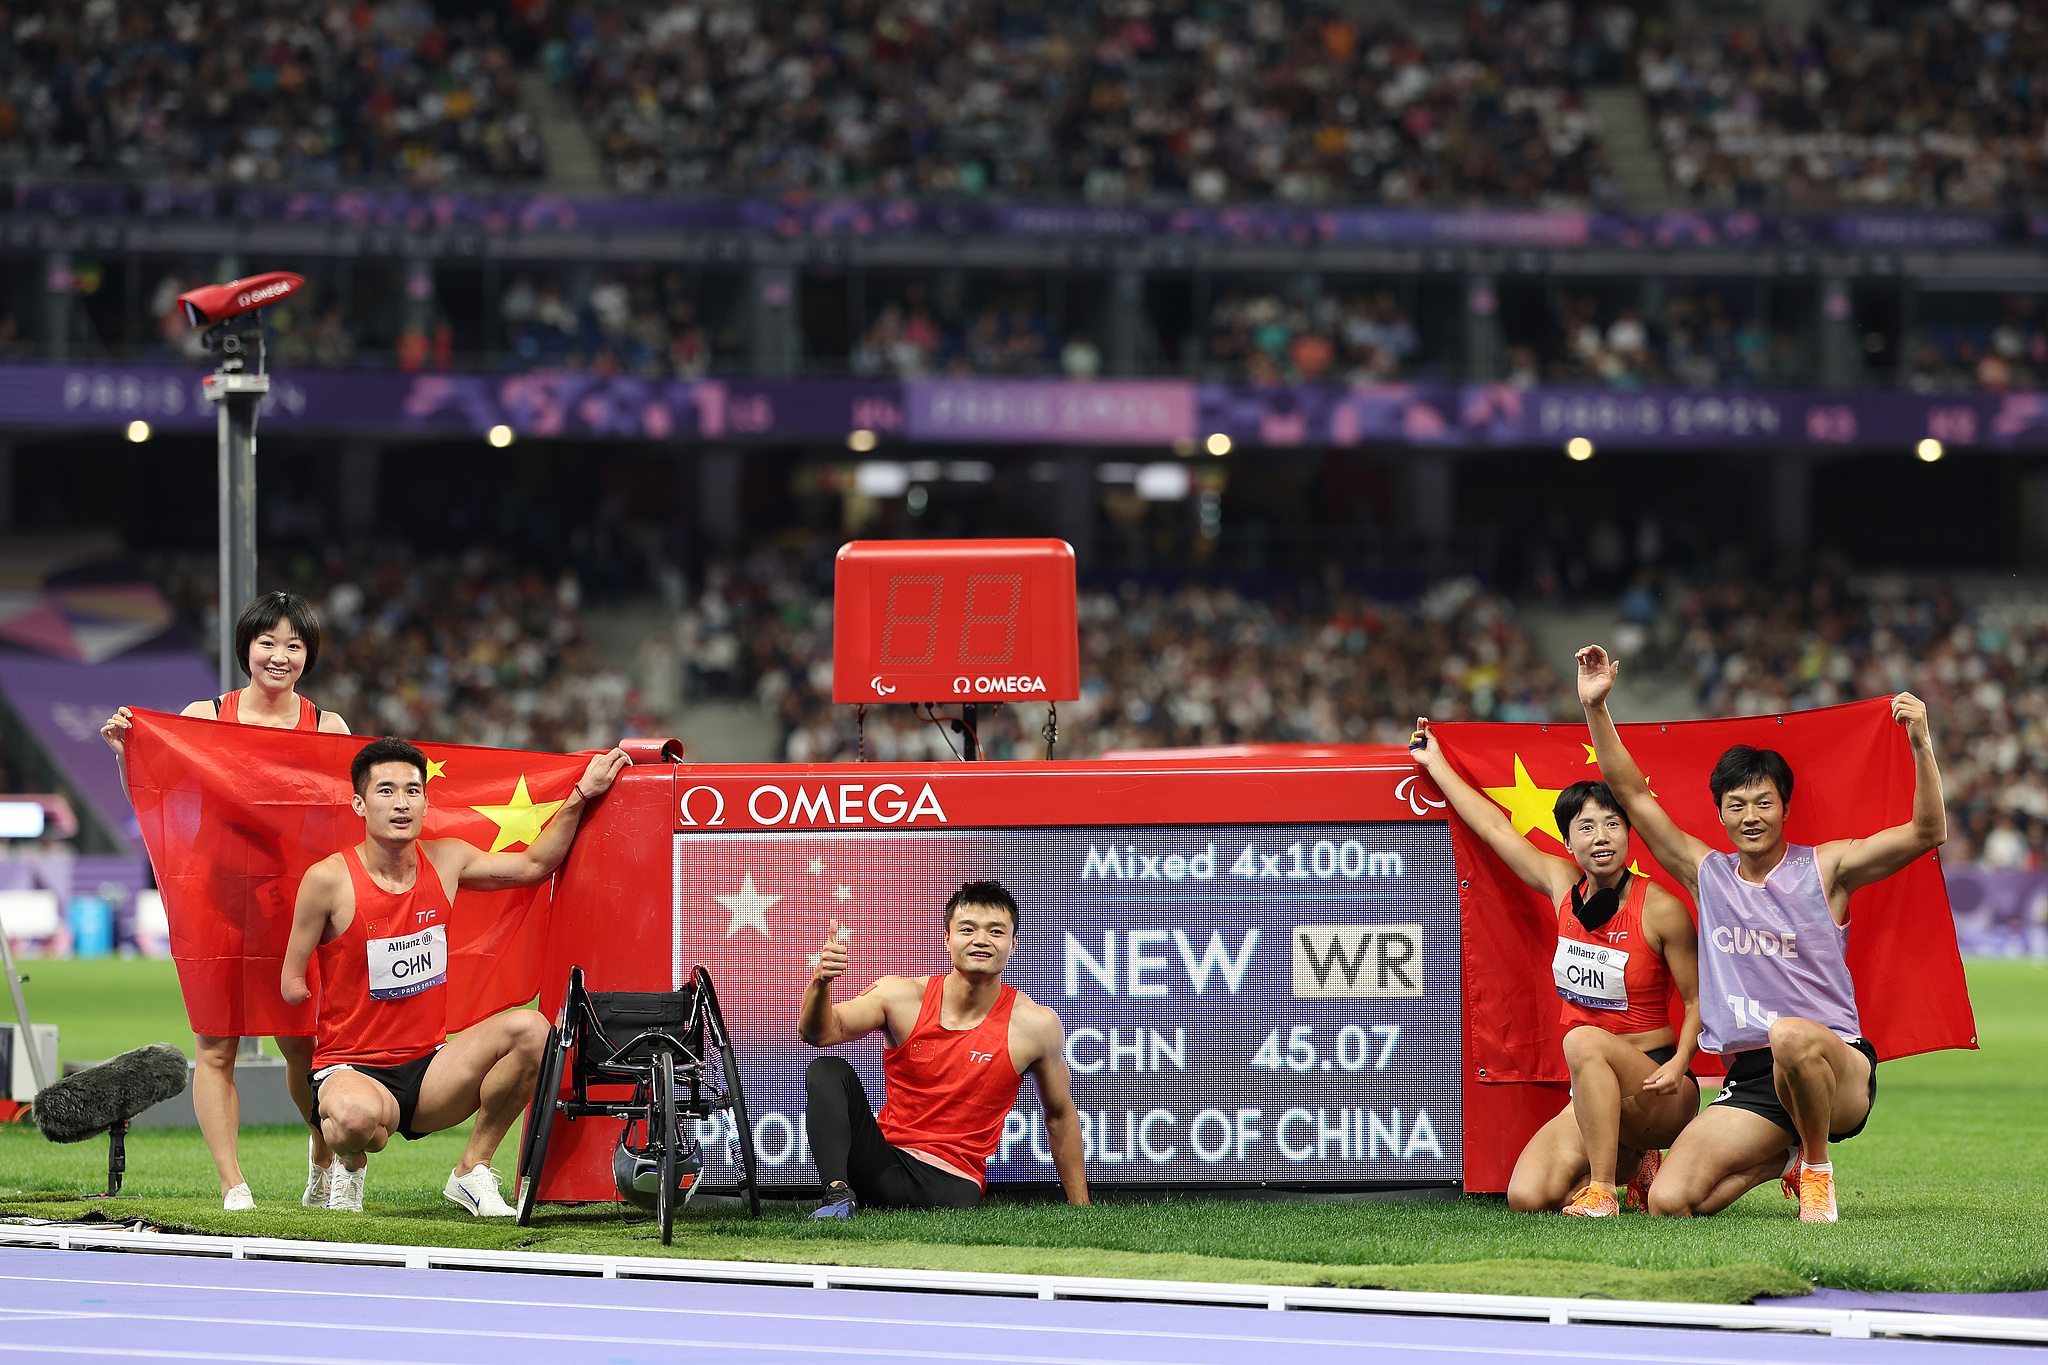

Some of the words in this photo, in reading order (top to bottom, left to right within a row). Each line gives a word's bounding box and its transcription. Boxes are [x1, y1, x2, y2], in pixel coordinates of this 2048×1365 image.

[250, 280, 291, 303] OMEGA
[974, 676, 1047, 693] OMEGA
[748, 782, 948, 825] OMEGA
[1081, 842, 1217, 880] Mixed
[1227, 840, 1405, 879] 4x100m
[387, 939, 421, 953] Allianz
[1567, 944, 1596, 960] Allianz
[1711, 925, 1799, 959] GUIDE
[391, 951, 432, 979] CHN
[1065, 928, 1262, 998] NEW
[1299, 932, 1417, 990] WR
[1567, 965, 1605, 990] CHN
[1065, 1027, 1186, 1074] CHN
[1250, 1024, 1401, 1072] 45.07
[1190, 1107, 1264, 1163] OF
[1275, 1106, 1445, 1163] CHINA
